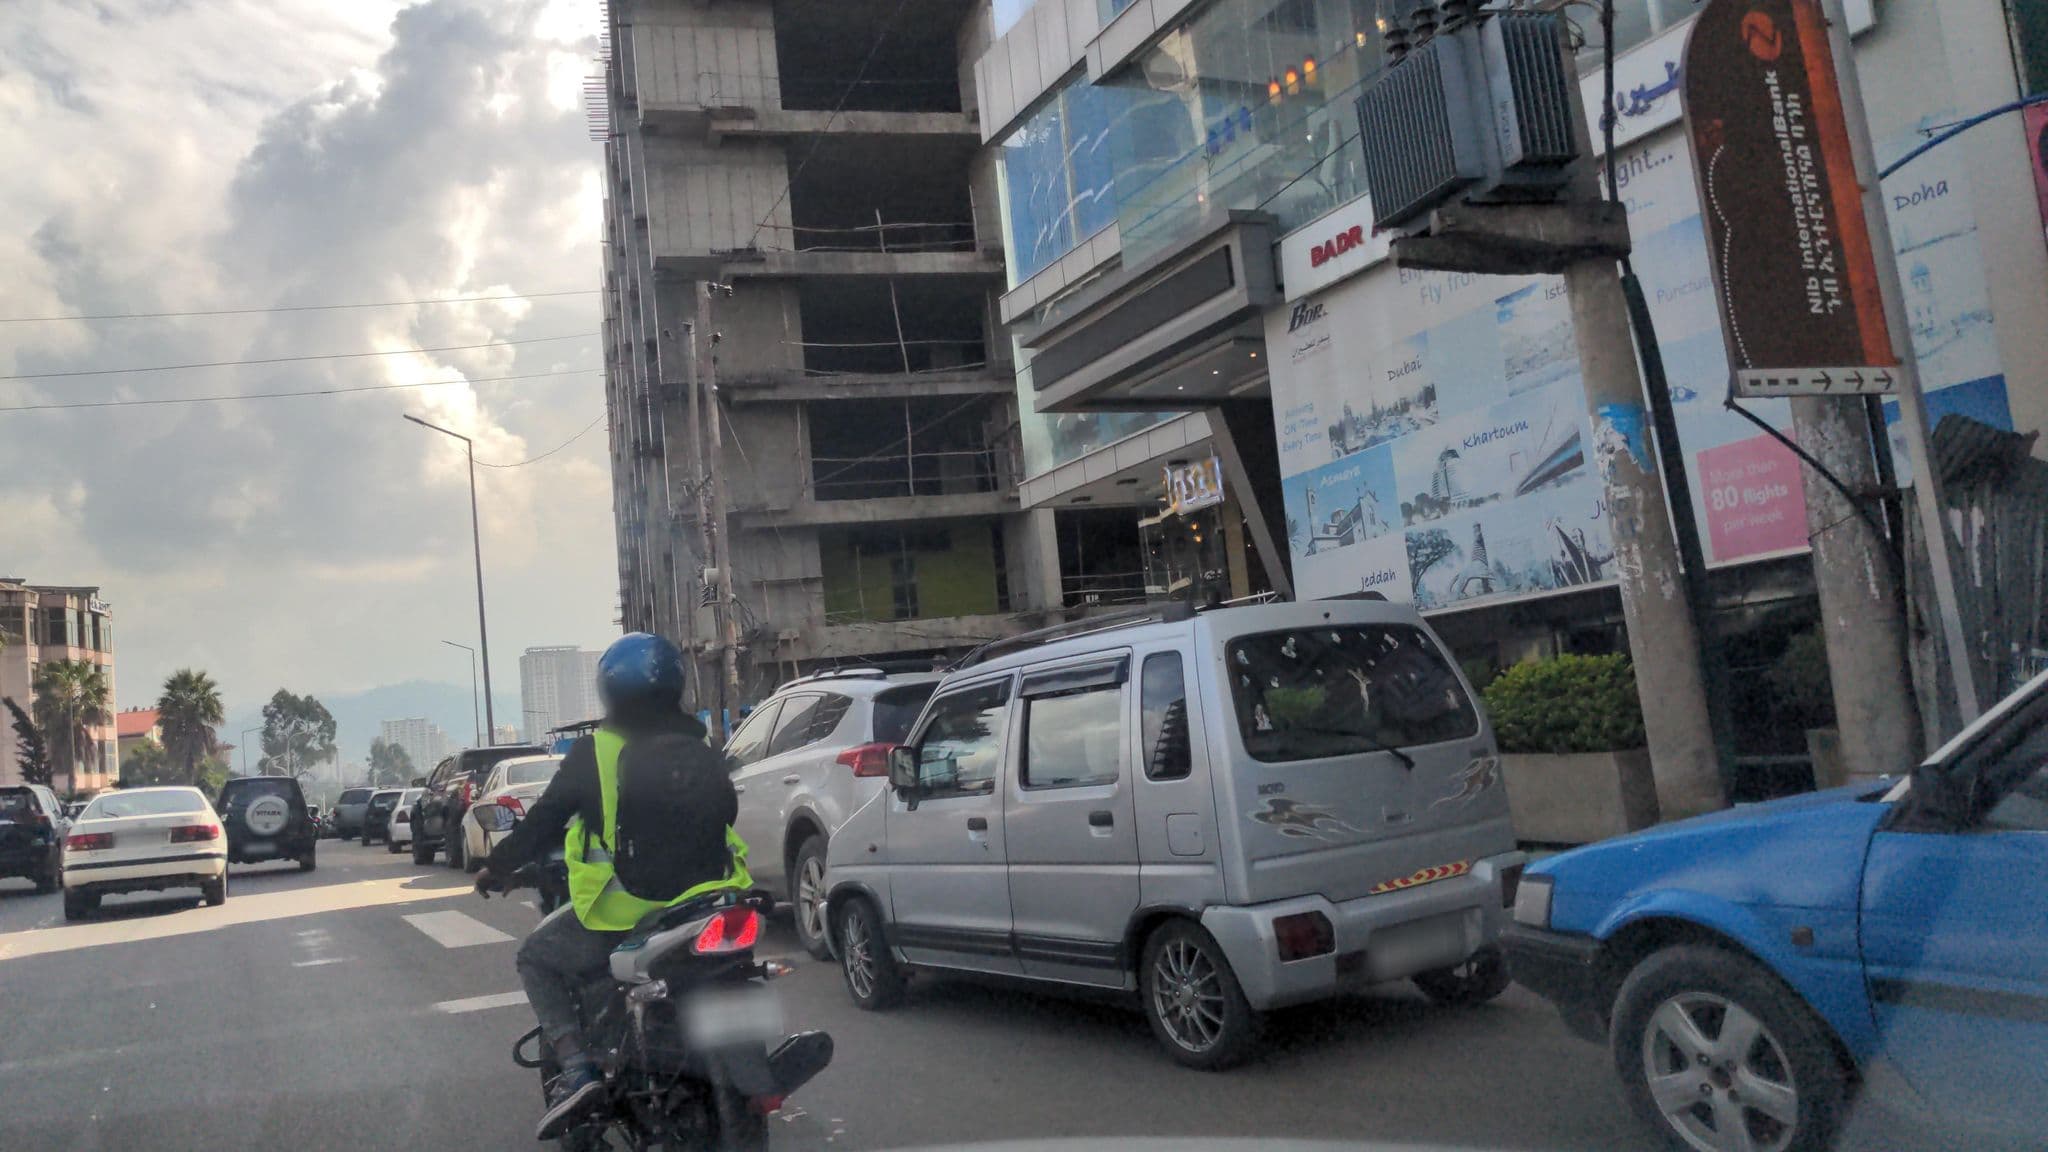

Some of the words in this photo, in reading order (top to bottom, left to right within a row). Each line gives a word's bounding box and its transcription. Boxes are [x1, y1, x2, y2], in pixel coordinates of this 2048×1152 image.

[1894, 179, 1949, 211] Doha
[1311, 225, 1364, 268] BADR
[1387, 354, 1423, 381] Dubai
[1463, 419, 1529, 451] Khartoum
[1711, 484, 1739, 512] 80
[1743, 483, 1789, 506] flights
[1360, 568, 1396, 593] Jeddah
